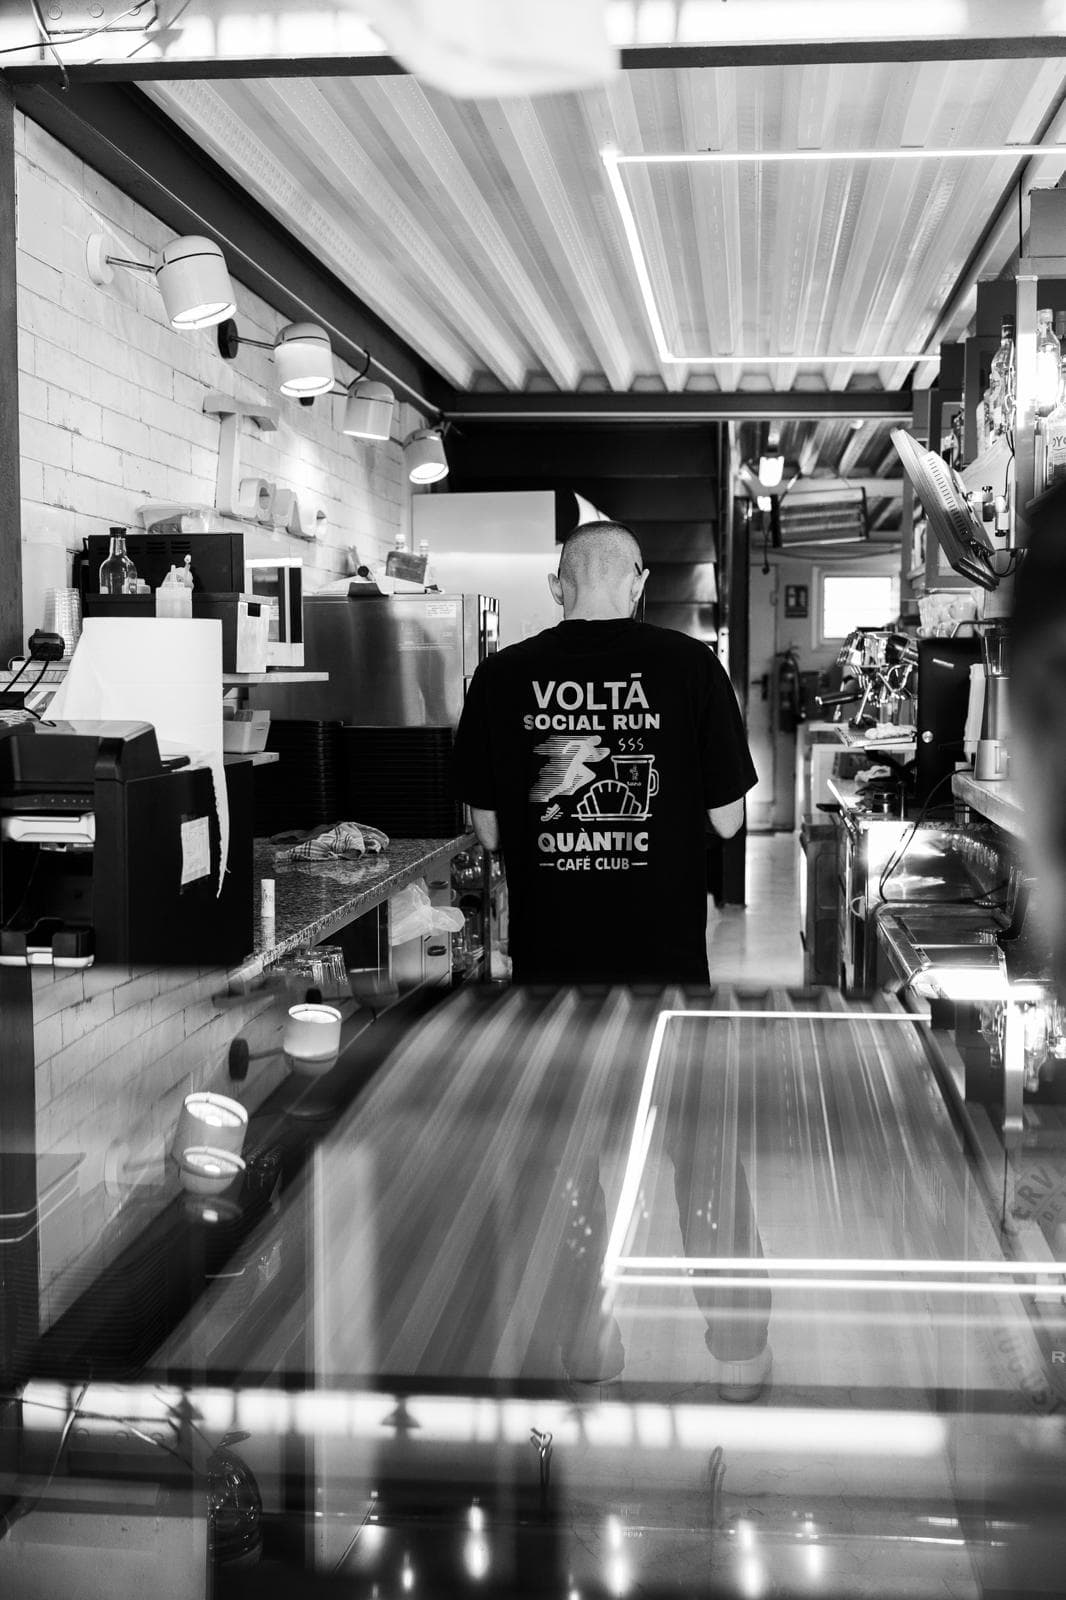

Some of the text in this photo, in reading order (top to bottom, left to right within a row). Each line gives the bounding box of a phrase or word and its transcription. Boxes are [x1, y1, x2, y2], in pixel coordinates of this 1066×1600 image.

[523, 713, 660, 730] SOCIAL RUN
[538, 828, 649, 853] QUÀNTIC
[556, 856, 630, 870] CAFÉ CLUB
